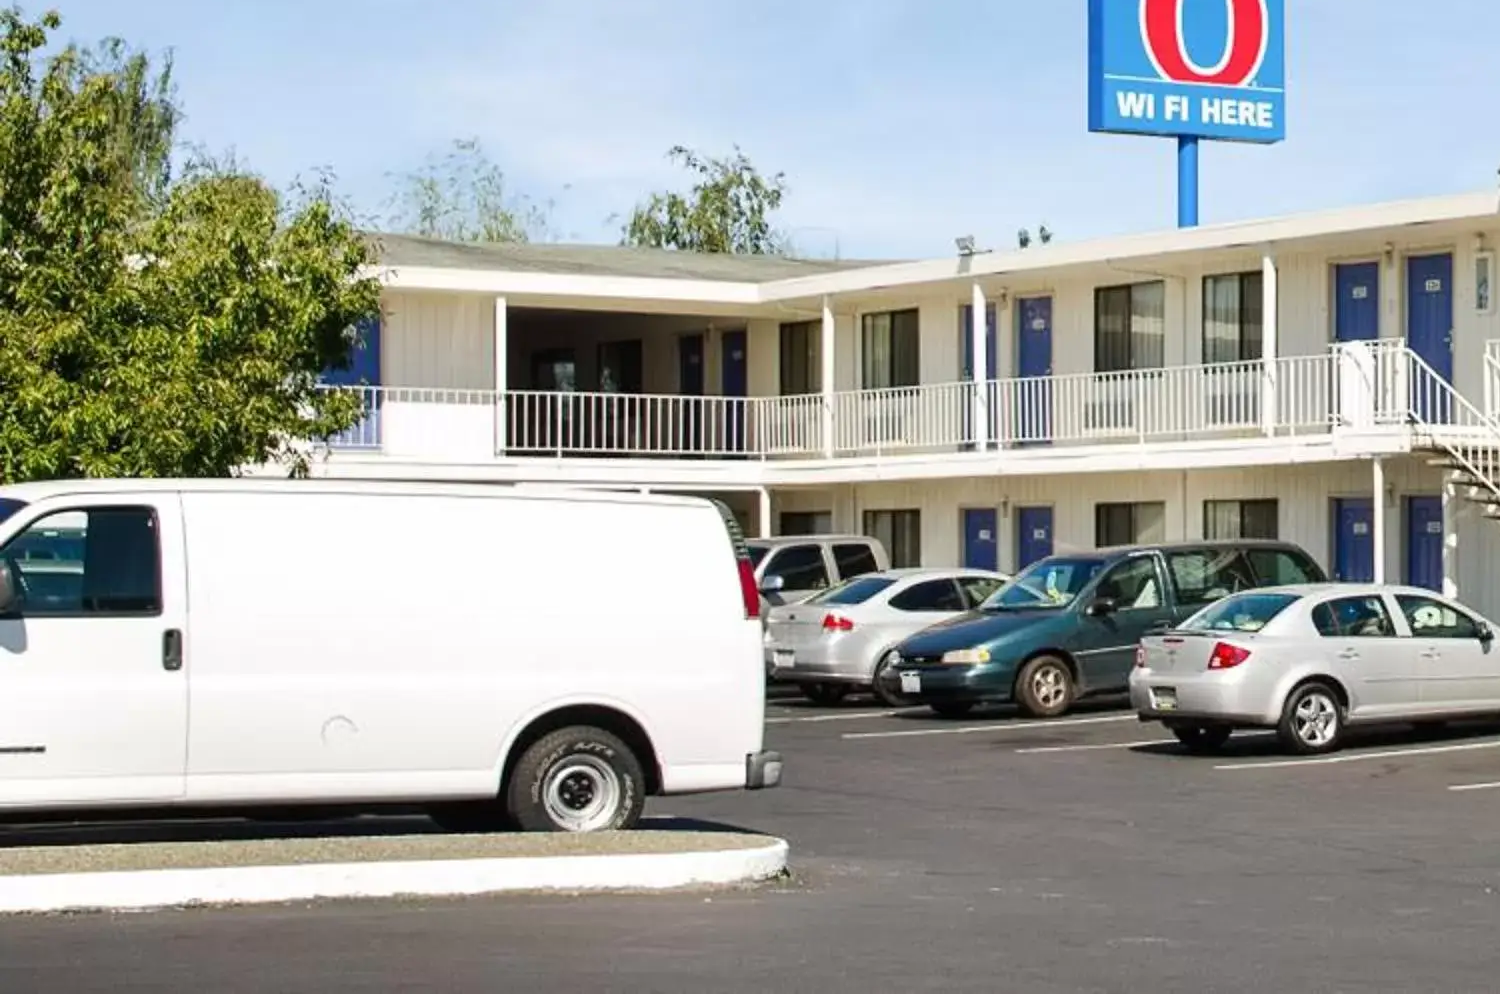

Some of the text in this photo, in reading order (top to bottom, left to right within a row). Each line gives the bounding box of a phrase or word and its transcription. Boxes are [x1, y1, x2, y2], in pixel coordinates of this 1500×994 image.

[1116, 91, 1273, 128] WI FI HERE
